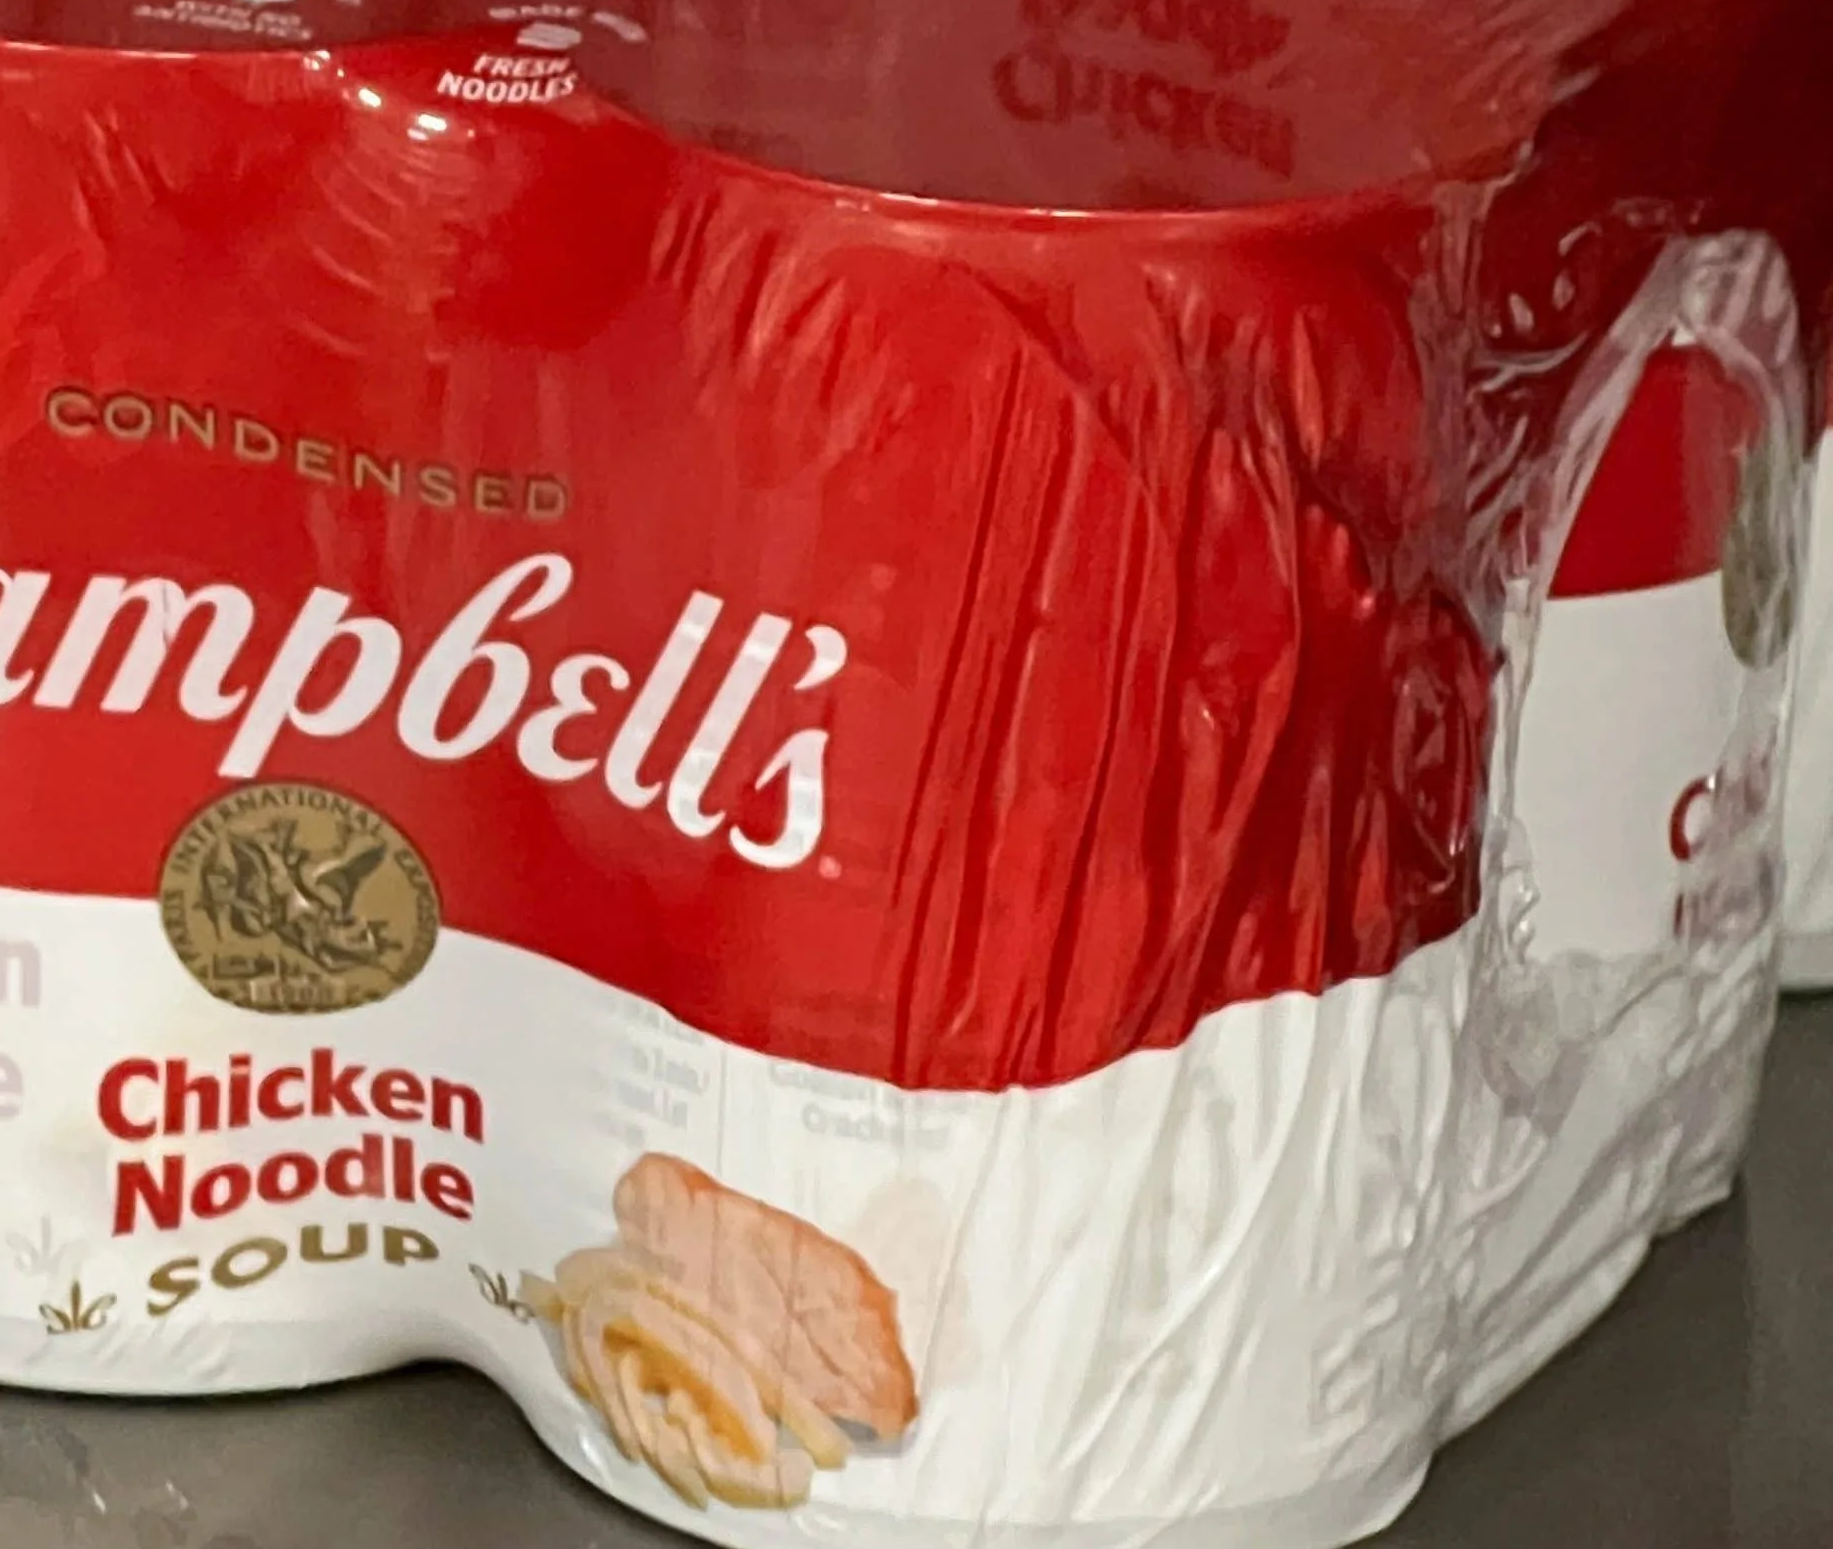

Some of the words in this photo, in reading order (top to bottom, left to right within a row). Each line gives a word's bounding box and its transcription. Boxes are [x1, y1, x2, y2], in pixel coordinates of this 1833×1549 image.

[436, 70, 580, 103] NOODLES
[472, 52, 571, 78] FRESH
[45, 386, 572, 522] CONDENSED
[96, 1047, 485, 1145] Chicken
[110, 1133, 476, 1237] Noodle
[146, 1221, 442, 1318] SOUP
